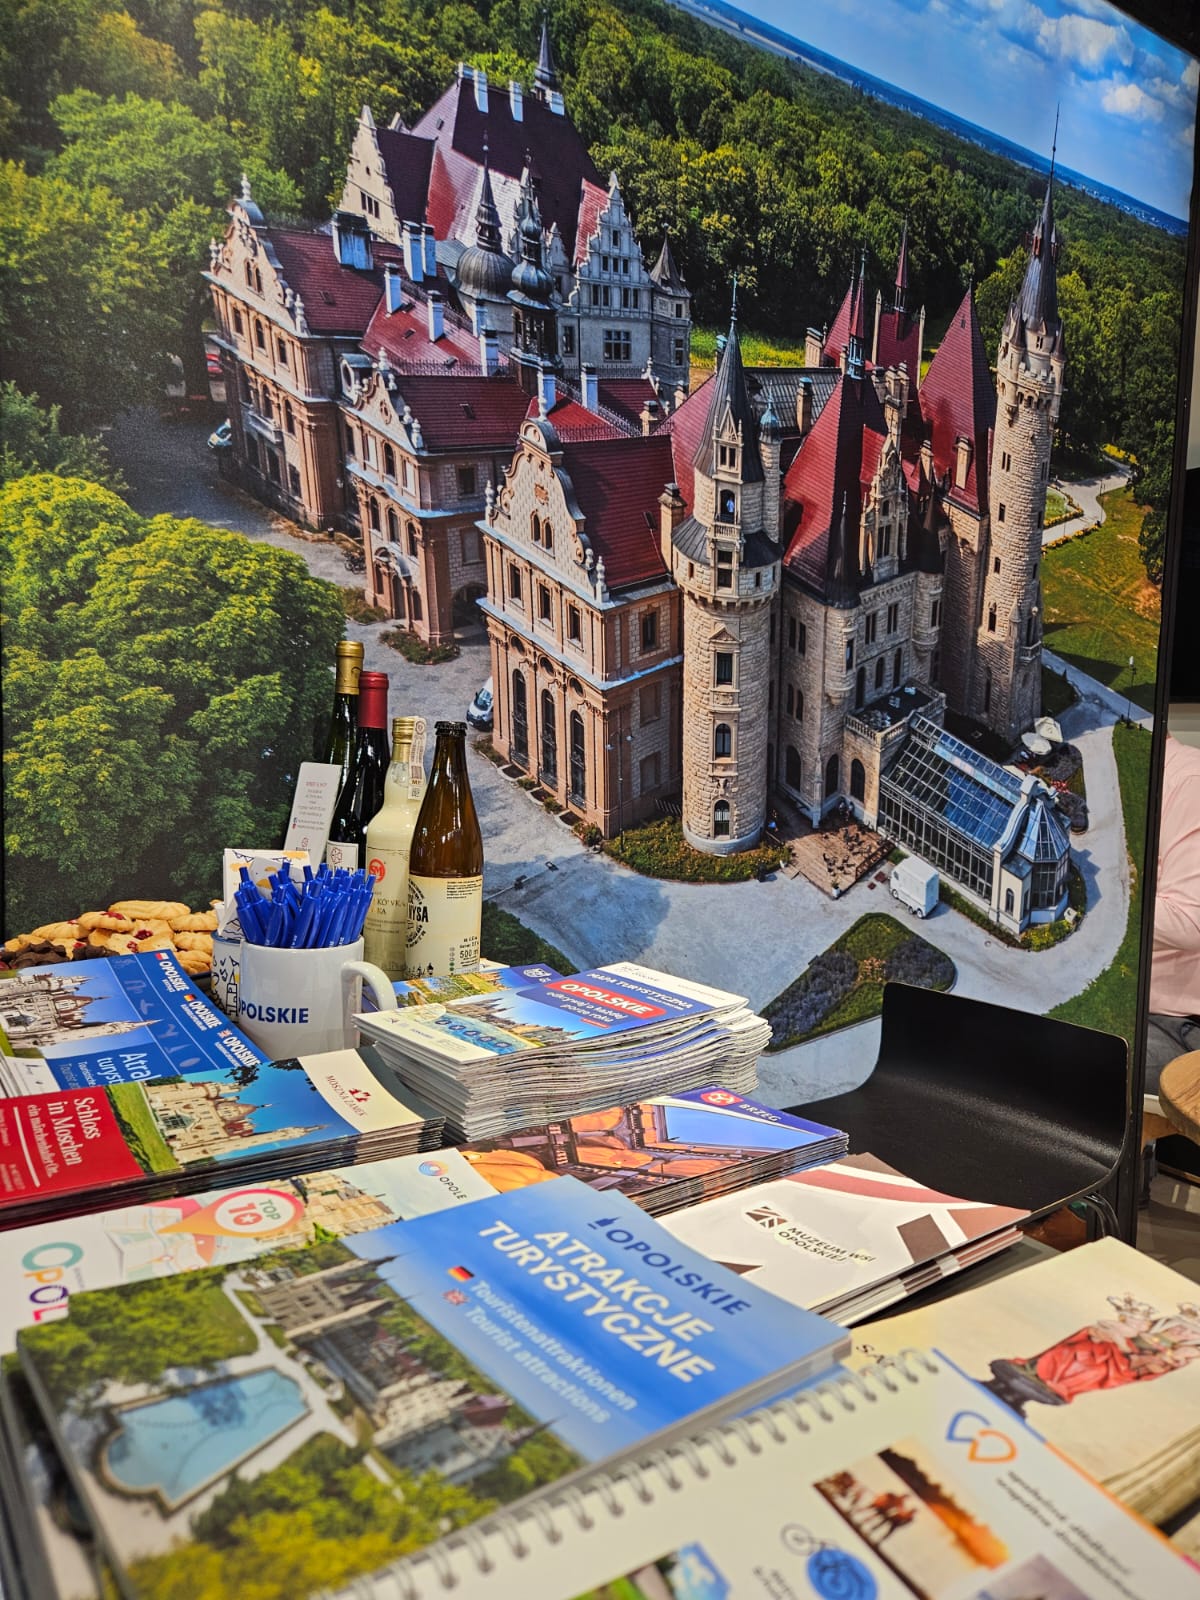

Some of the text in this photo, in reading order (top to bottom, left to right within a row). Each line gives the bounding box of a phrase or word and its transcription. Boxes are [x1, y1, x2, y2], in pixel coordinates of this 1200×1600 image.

[159, 961, 191, 993] OPOLSKIE
[586, 972, 613, 984] MAPA
[615, 979, 694, 1009] TURYSTYCZNA
[190, 1000, 223, 1029] OPOLSKIE
[560, 982, 655, 1015] OPOLSKIE
[224, 1036, 261, 1067] OPOLSKIE
[47, 1100, 69, 1115] in
[73, 1096, 101, 1140] Schloss
[738, 1102, 781, 1122] BRZEG
[51, 1115, 84, 1167] Moschen
[439, 1175, 467, 1200] OPOLE
[228, 1202, 263, 1226] 10
[259, 1199, 282, 1220] TOP
[778, 1230, 848, 1263] OPOLSKIEJ
[787, 1226, 876, 1263] MUZEUM WSI
[535, 1230, 716, 1343] ATRAKCJE
[605, 1226, 752, 1317] OPOLSKIE
[478, 1220, 717, 1384] TURYSTYCZNE
[469, 1278, 639, 1411] Touristenattraktionen
[463, 1305, 612, 1424] Tourist attractions
